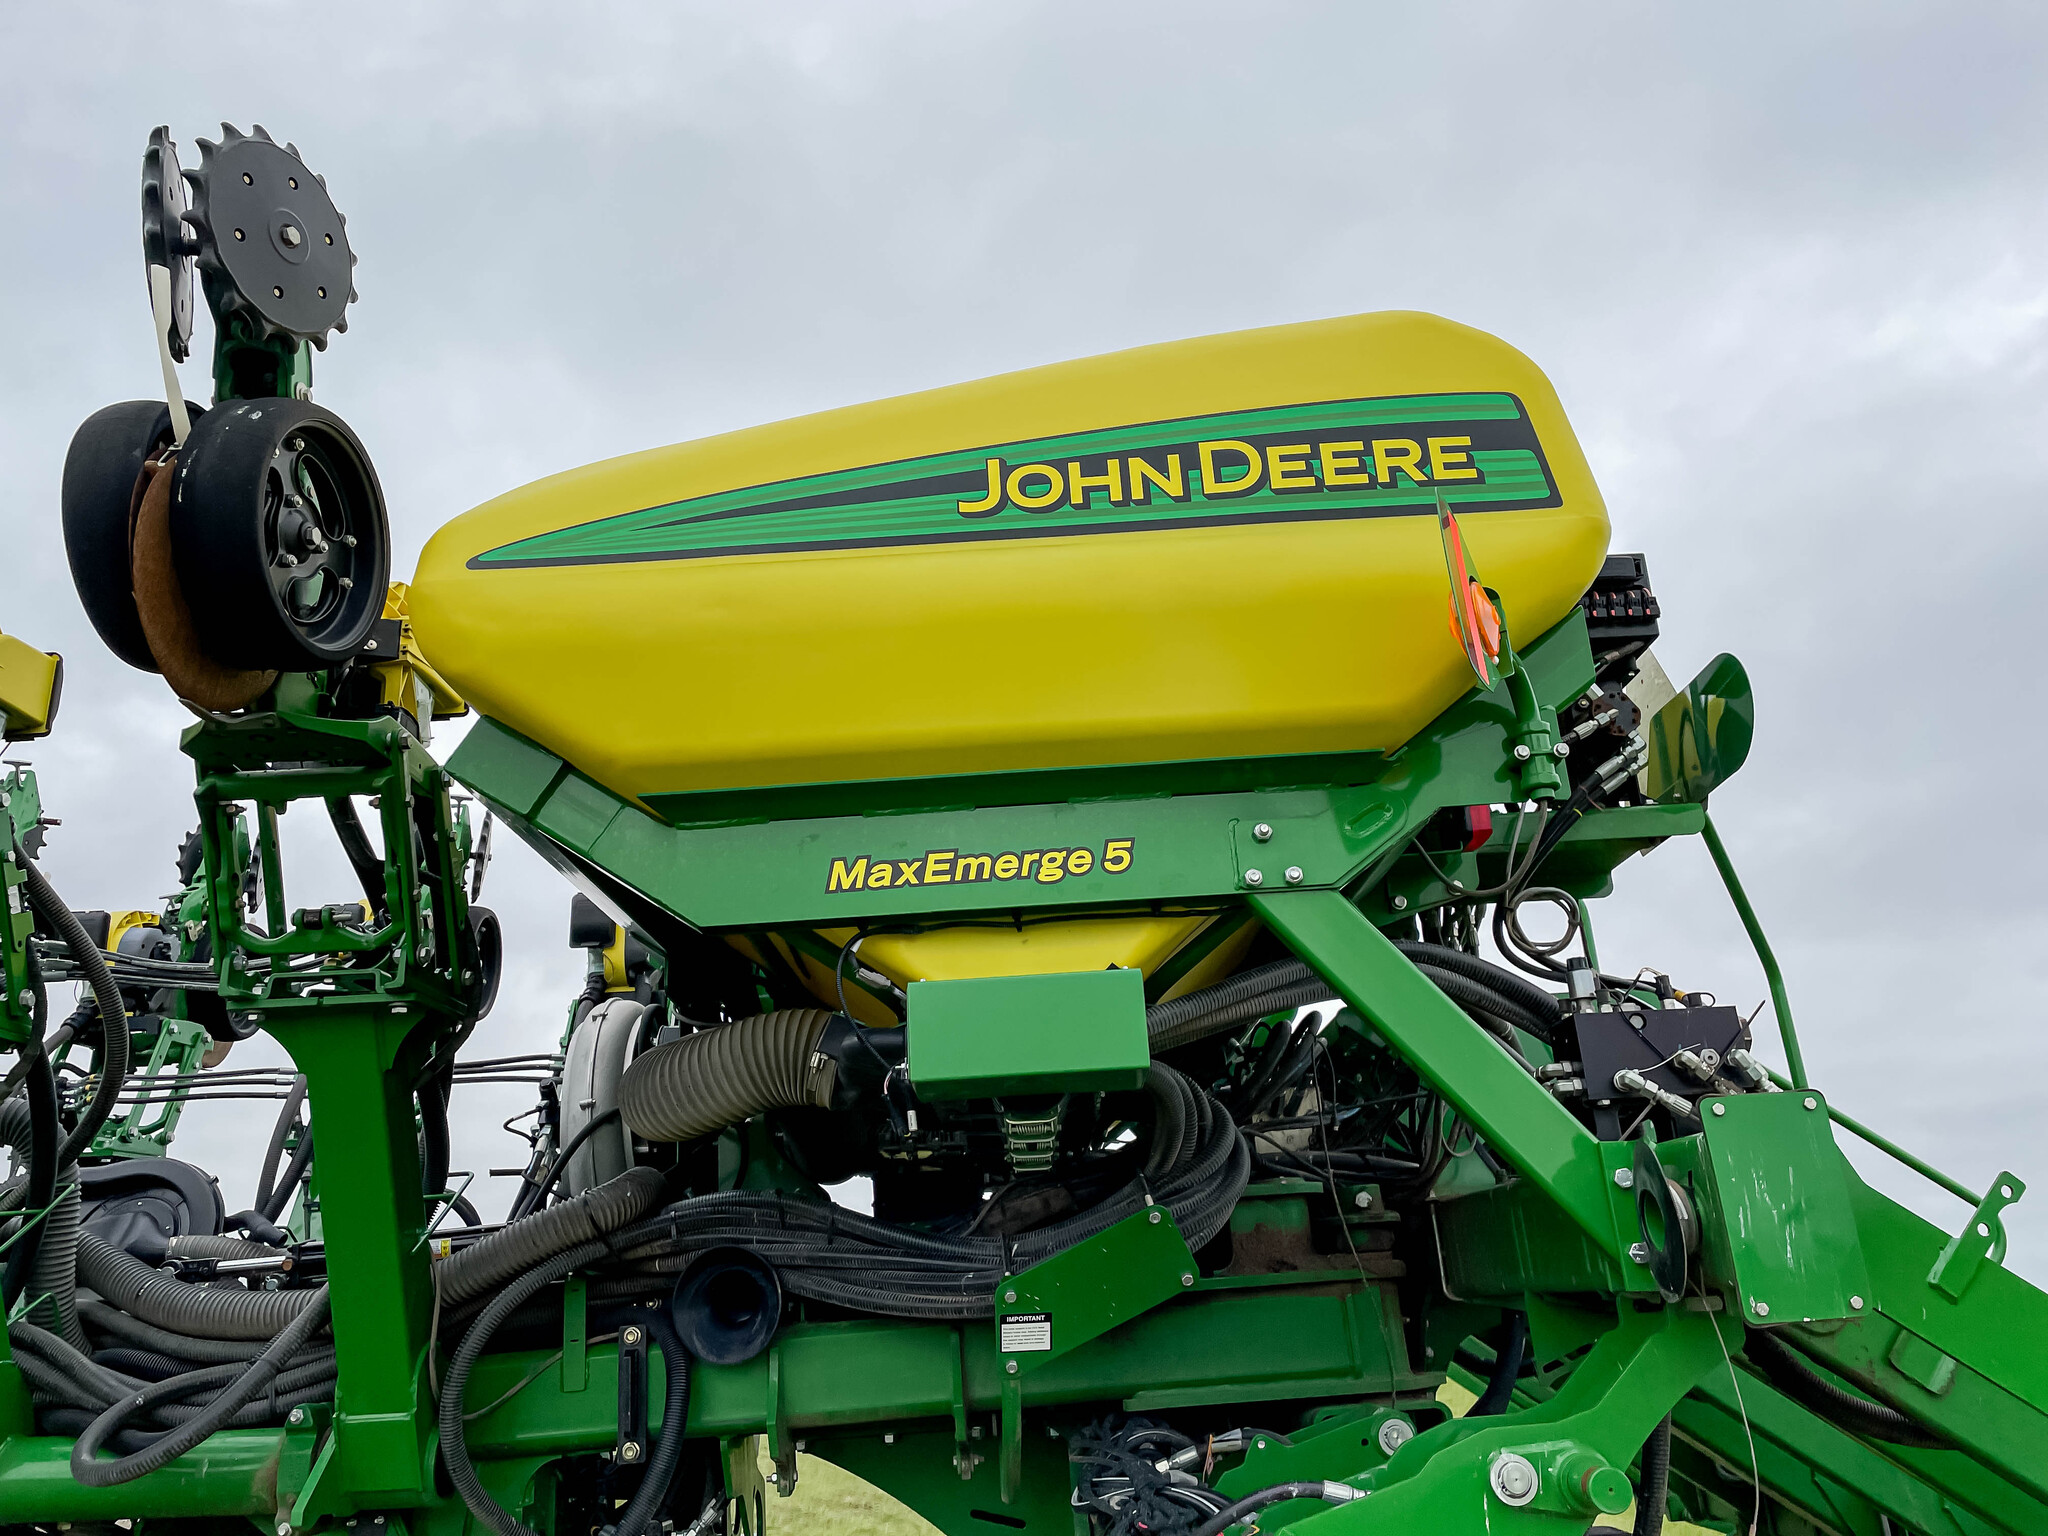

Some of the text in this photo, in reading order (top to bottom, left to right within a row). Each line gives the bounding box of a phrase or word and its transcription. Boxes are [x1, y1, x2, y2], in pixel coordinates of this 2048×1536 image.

[957, 436, 1479, 514] JOHN DEERE
[827, 840, 1133, 892] MaxEmerge 5
[1006, 1315, 1046, 1323] IMPORTANT
